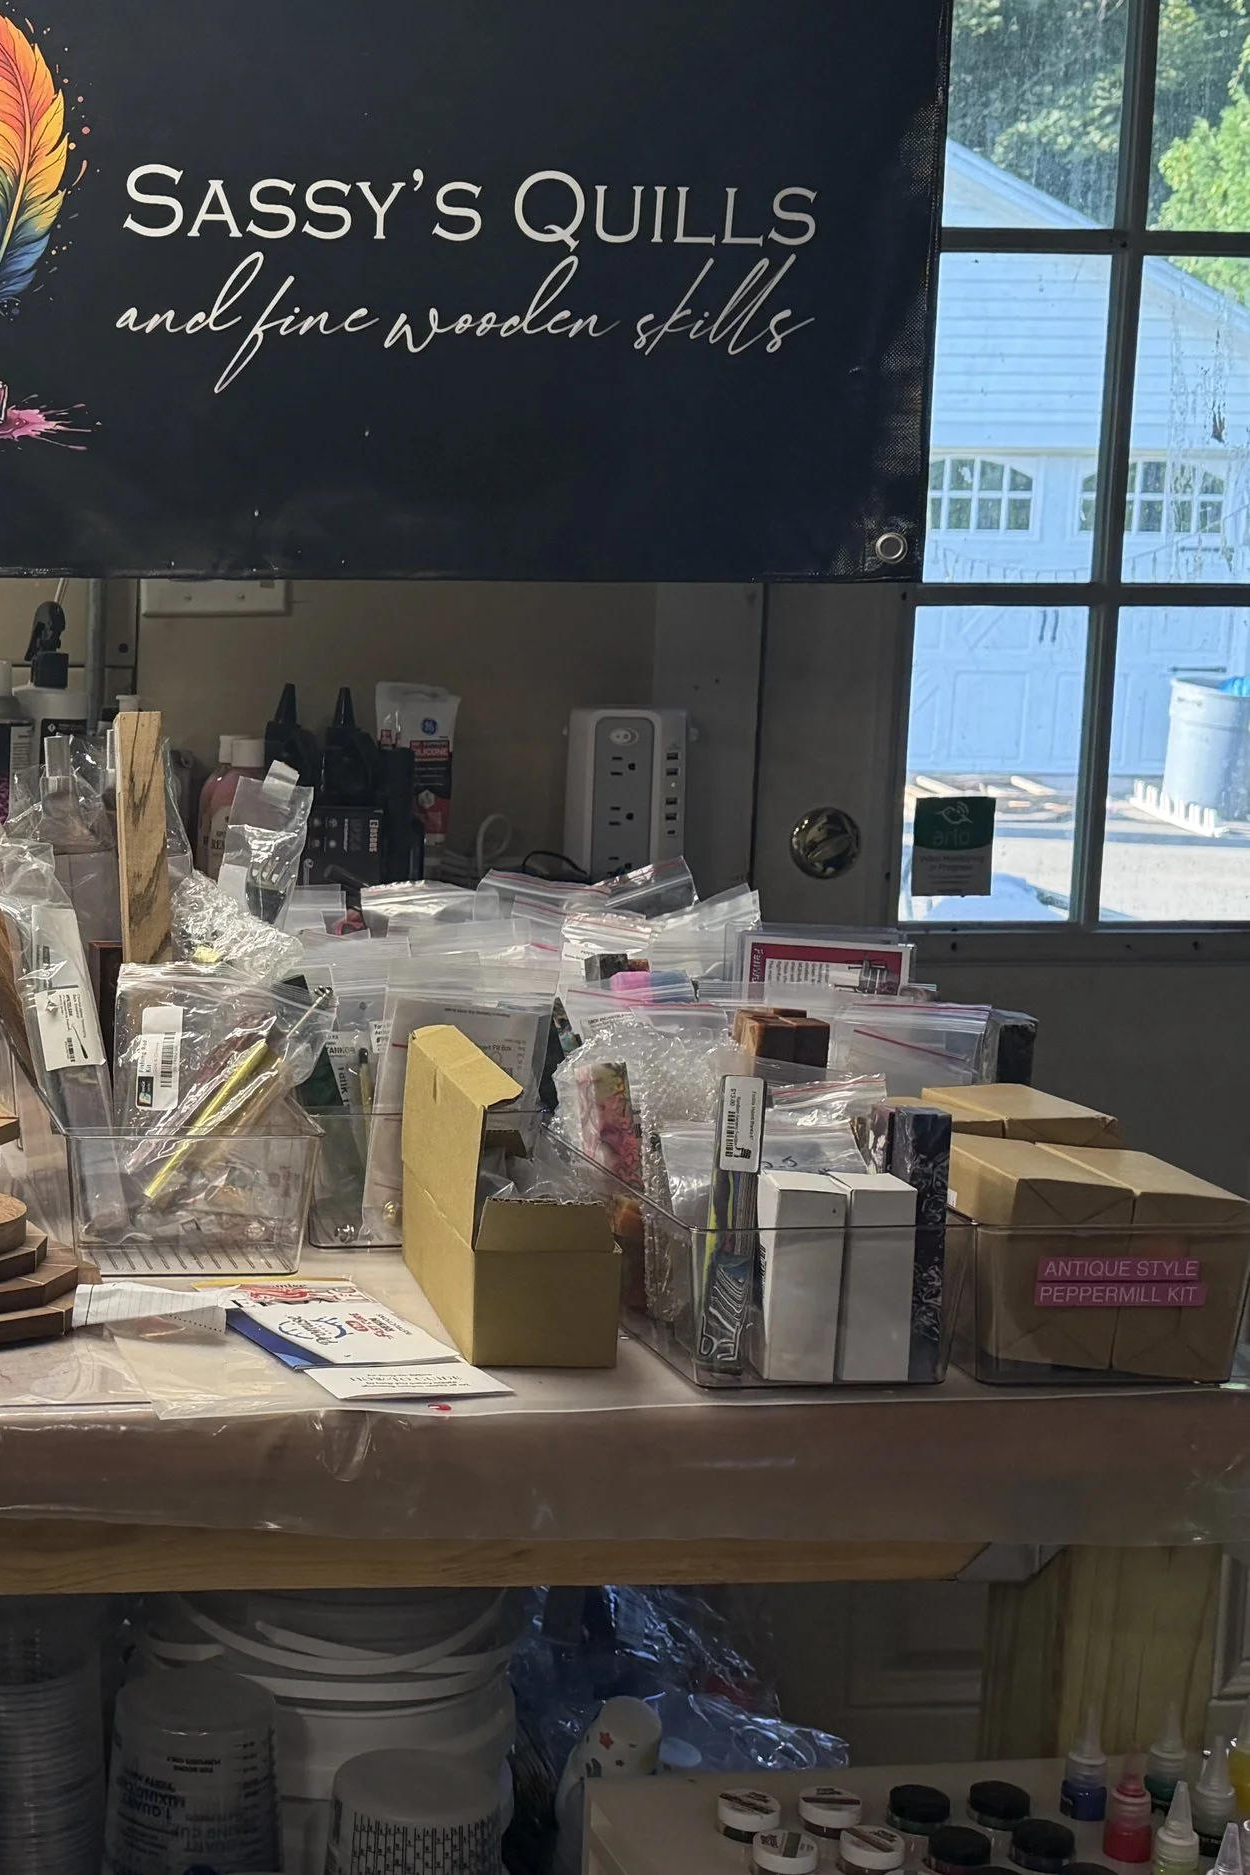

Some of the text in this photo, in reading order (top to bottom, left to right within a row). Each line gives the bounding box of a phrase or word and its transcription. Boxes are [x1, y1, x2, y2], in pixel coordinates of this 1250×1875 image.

[514, 169, 818, 252] QUILLS
[115, 250, 816, 395] and fine wooden skills
[139, 1039, 148, 1073] Fishing Rod
[1044, 1260, 1200, 1277] ANTIQUE STYLE
[1039, 1286, 1199, 1303] PEPPERMILL KIT
